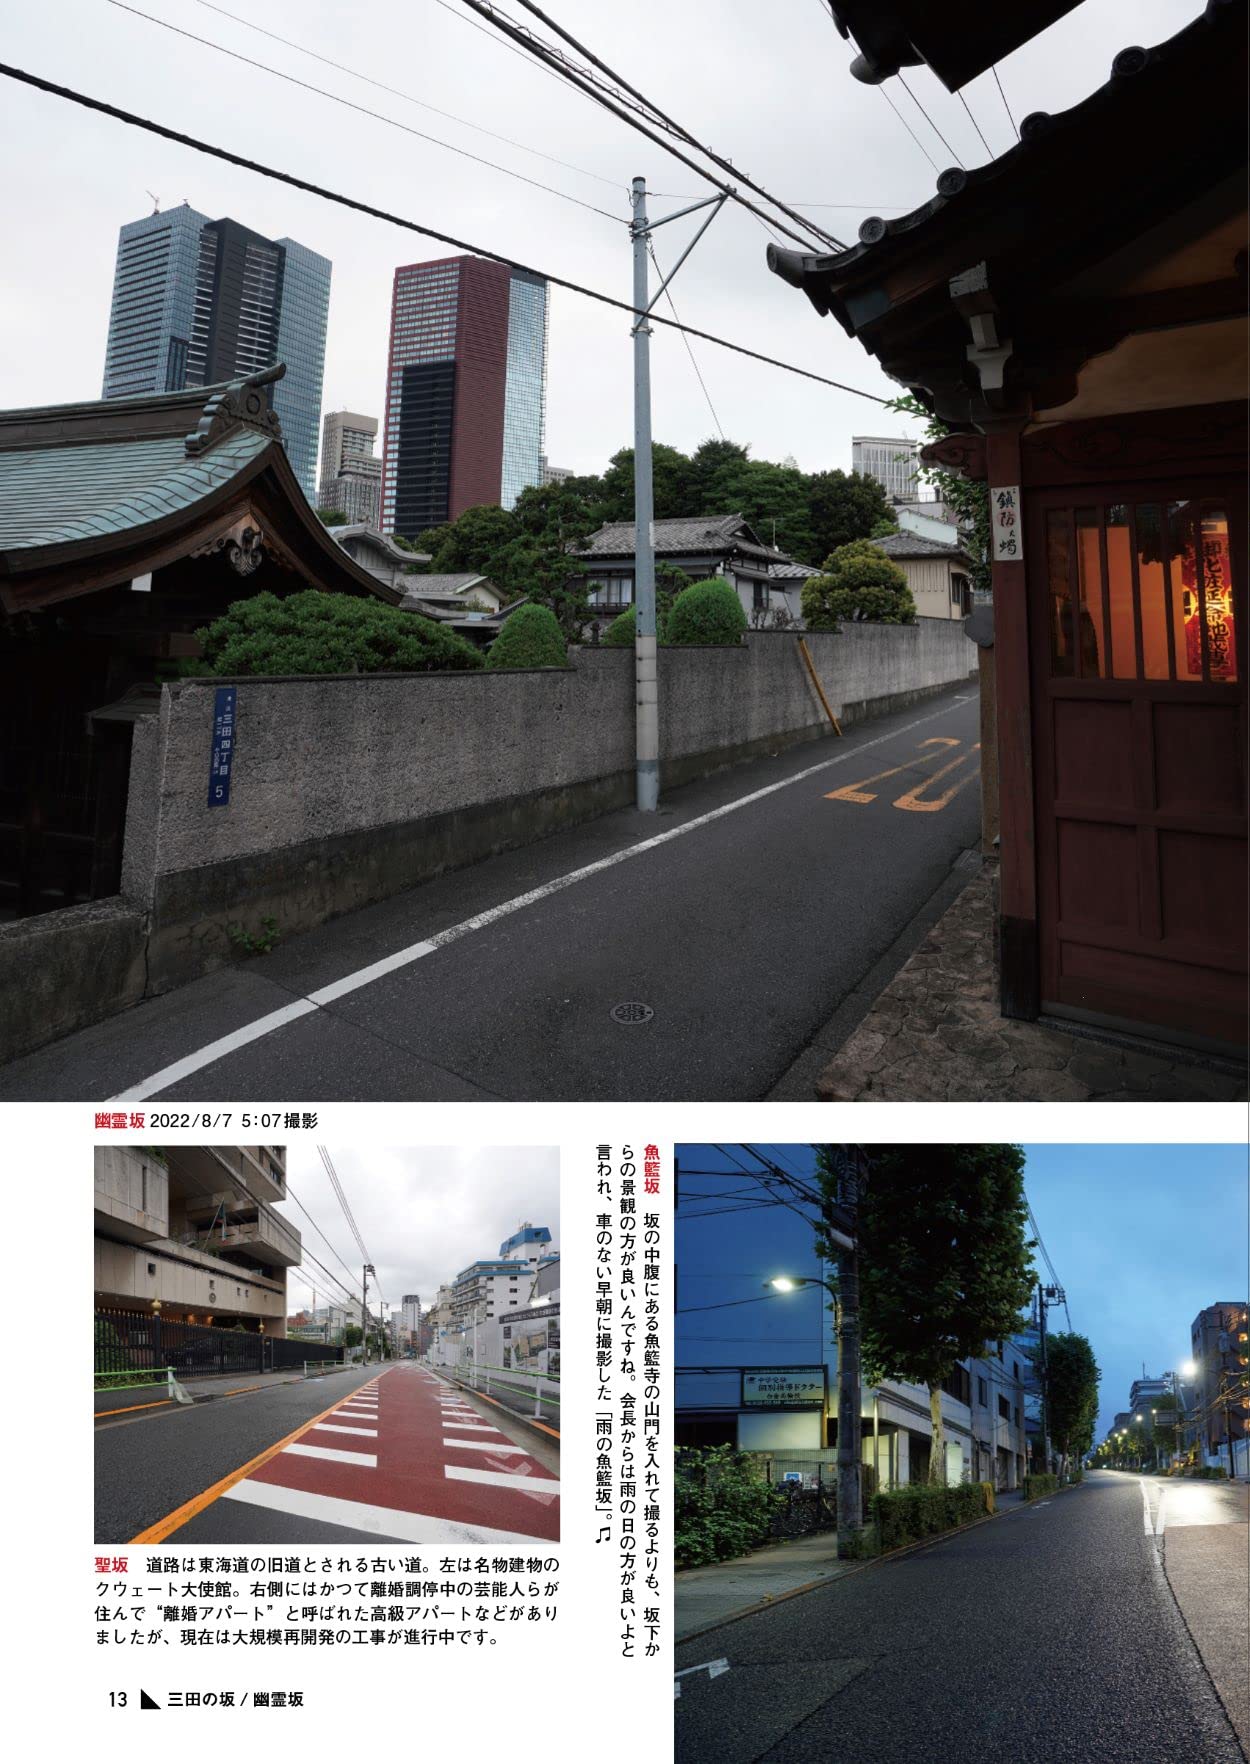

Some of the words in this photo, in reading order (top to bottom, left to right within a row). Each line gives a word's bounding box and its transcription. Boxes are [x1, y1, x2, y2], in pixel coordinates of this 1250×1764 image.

[214, 785, 224, 798] 5
[95, 1112, 145, 1129] 幽霊坂
[150, 1114, 232, 1127] 2022/8/7
[242, 1112, 318, 1129] 5:07撮影
[644, 1144, 660, 1194] 魚籃坂
[620, 1145, 636, 1657] らの景観の方が良いんですね。会長からは雨の日の方が良いよと
[95, 1557, 128, 1573] 聖坂
[147, 1557, 559, 1573] 道路は東海道の旧道とされる古い道。左は名物建物の
[96, 1581, 559, 1597] クウェート大使館。右側にはかつて離婚調停中の芸能人らが
[97, 1629, 496, 1645] ましたが、現在は大規模再開発の工事が進行中です。
[109, 1692, 127, 1707] 13
[168, 1692, 235, 1707] 三田の坂
[254, 1692, 304, 1707] 幽霊坂
